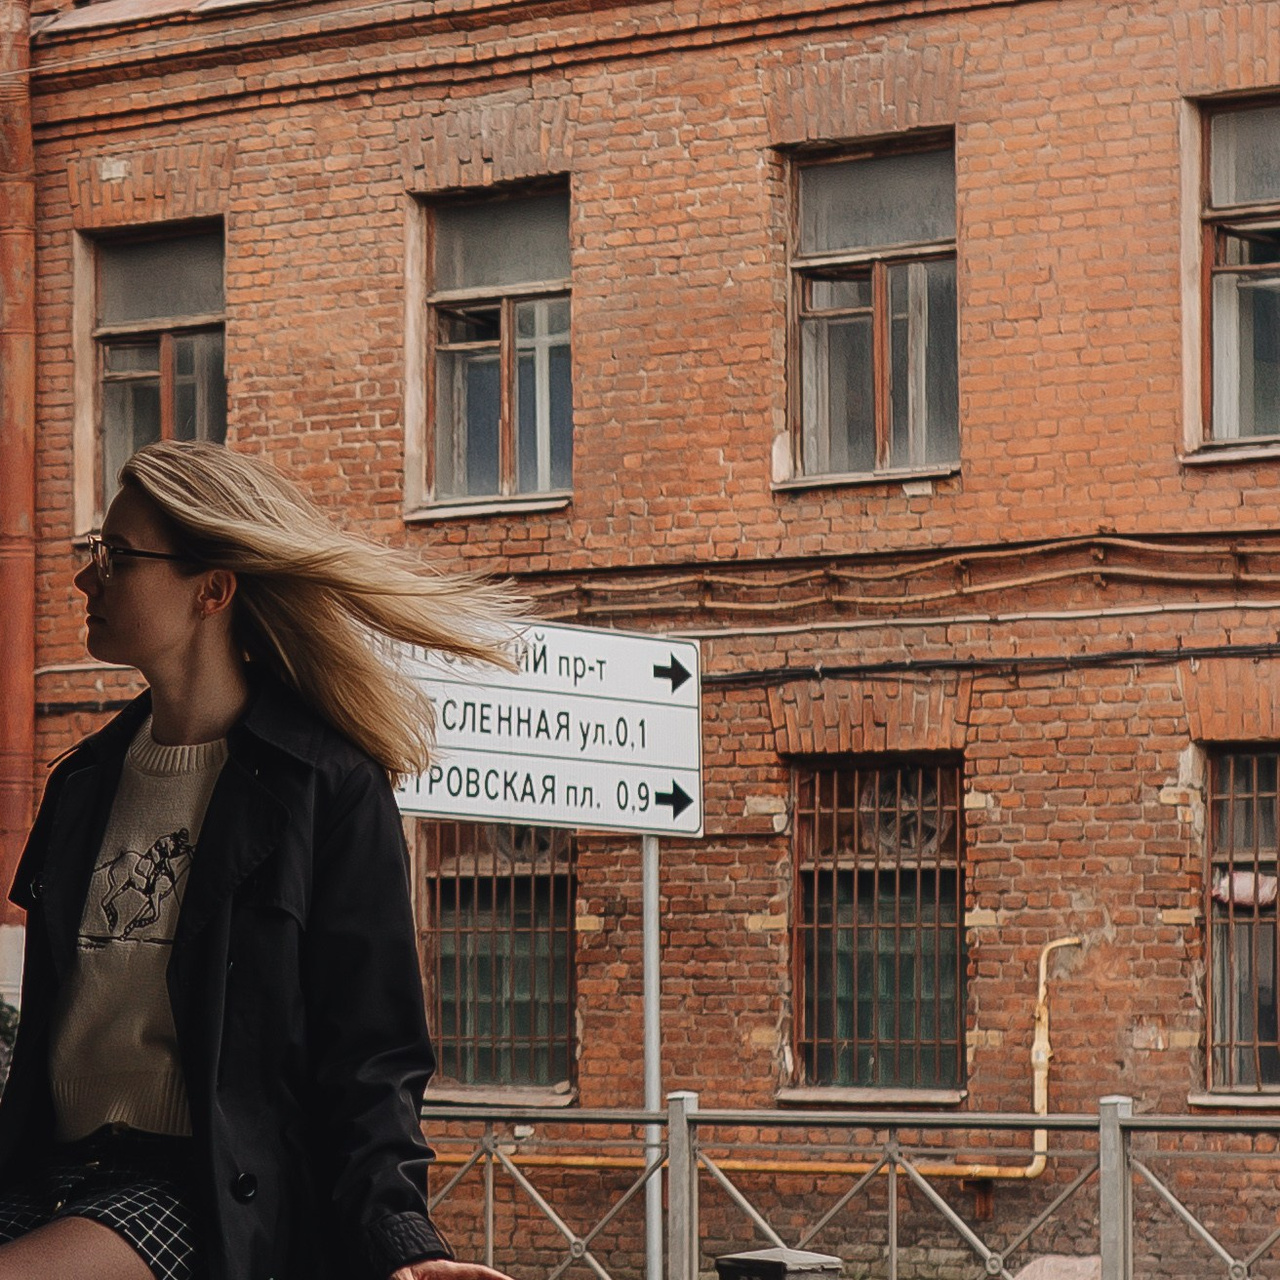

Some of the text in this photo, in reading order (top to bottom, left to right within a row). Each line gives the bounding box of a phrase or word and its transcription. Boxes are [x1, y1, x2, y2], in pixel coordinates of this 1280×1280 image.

[558, 654, 607, 687] пр-т
[429, 697, 570, 742] СЛЕННАЯ
[398, 764, 650, 814] РОВСКАЯ пл. 0,9
